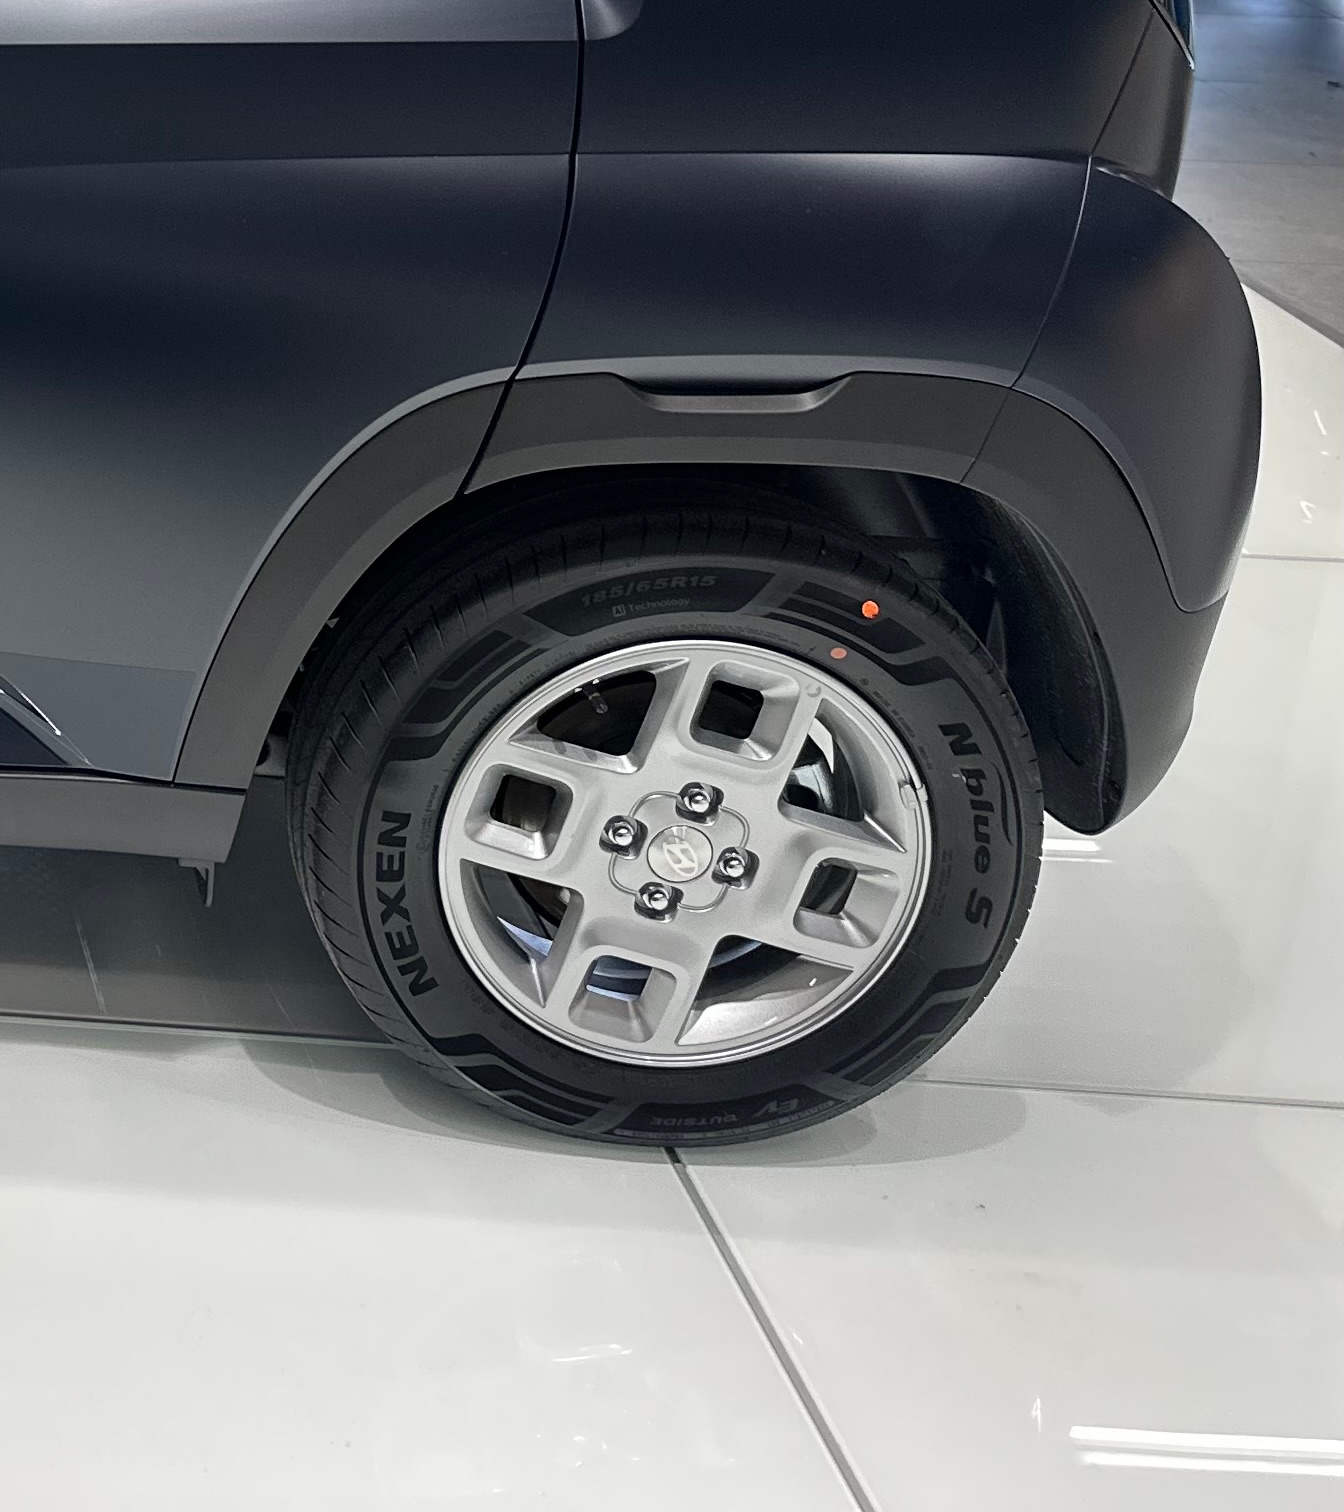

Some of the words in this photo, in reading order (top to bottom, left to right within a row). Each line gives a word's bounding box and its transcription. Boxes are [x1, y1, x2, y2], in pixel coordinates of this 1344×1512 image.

[580, 574, 719, 607] 185/65R15
[628, 597, 691, 615] Technology
[937, 722, 984, 758] N
[959, 767, 996, 875] blue
[375, 809, 440, 997] NEXEN
[964, 888, 995, 929] S
